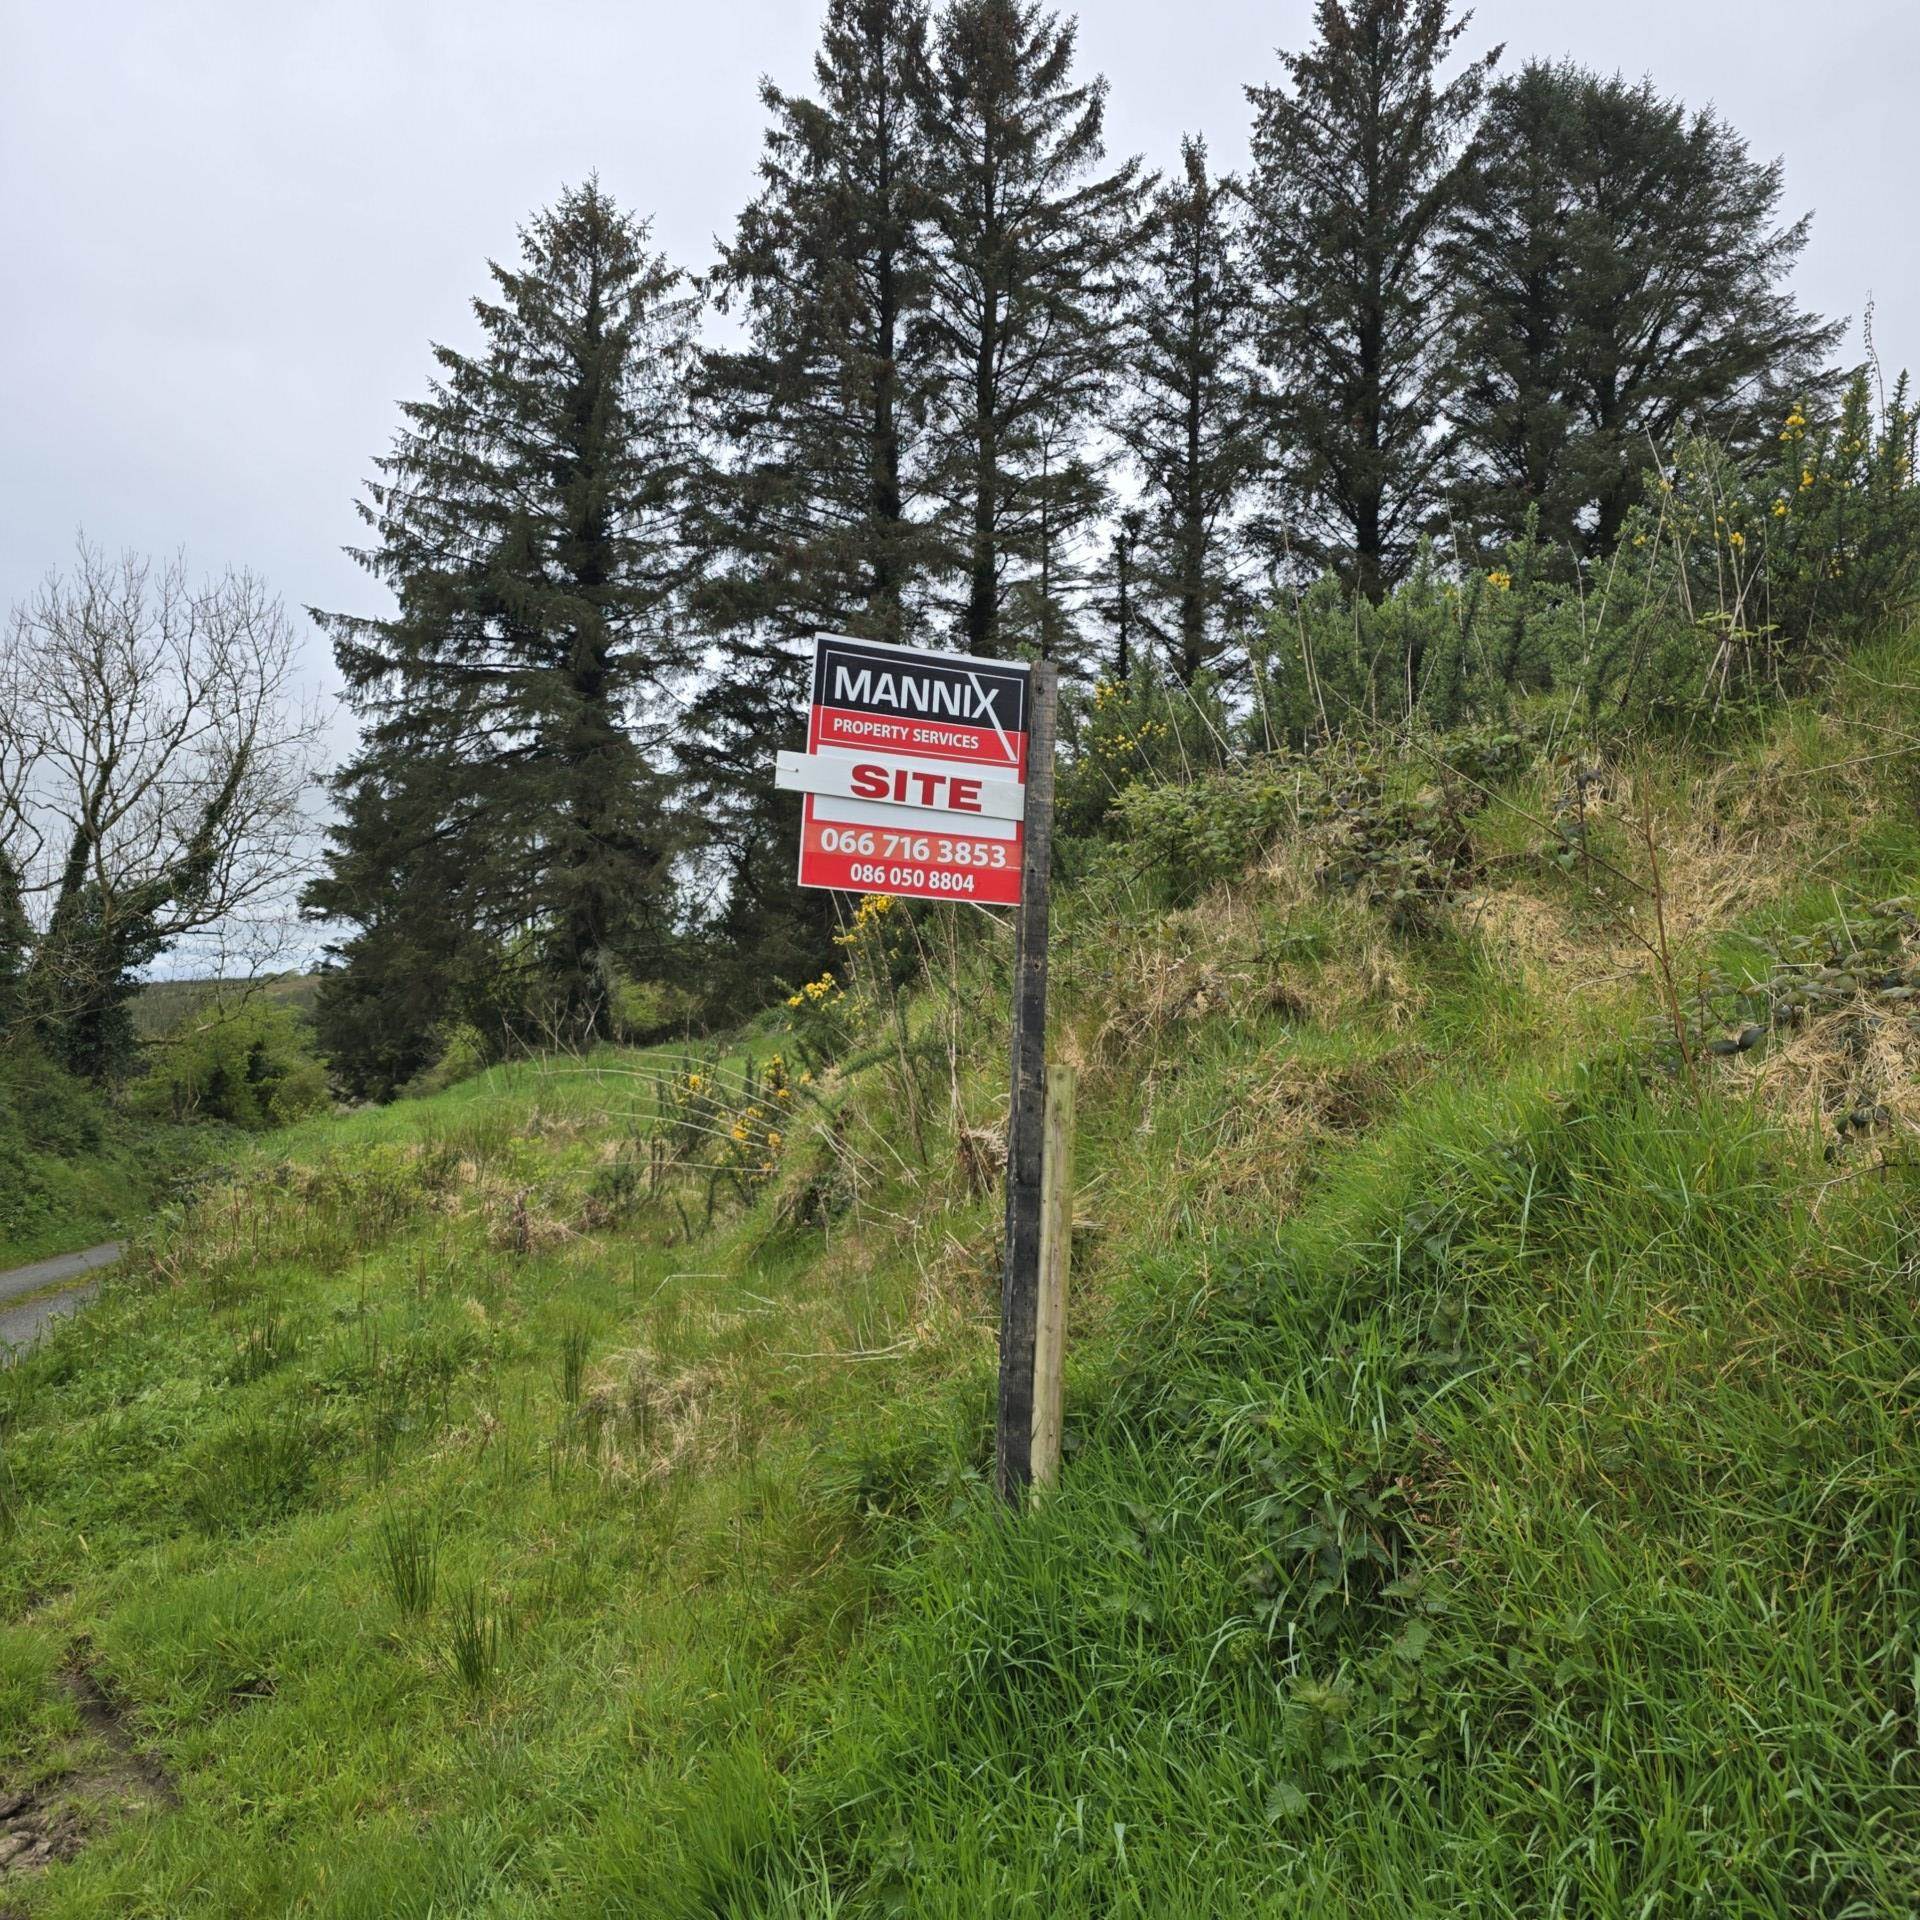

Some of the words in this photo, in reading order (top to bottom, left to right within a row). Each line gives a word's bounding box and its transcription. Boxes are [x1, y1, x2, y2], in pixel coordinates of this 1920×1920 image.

[834, 666, 1002, 728] MANNIX
[833, 718, 908, 740] PROPERTY
[913, 729, 979, 749] SERVICES
[851, 764, 982, 812] SITE
[821, 828, 874, 855] 066
[883, 835, 929, 860] 716
[937, 841, 1006, 868] 3853
[850, 863, 885, 884] 086
[890, 868, 924, 887] 050
[929, 871, 974, 892] 8804
